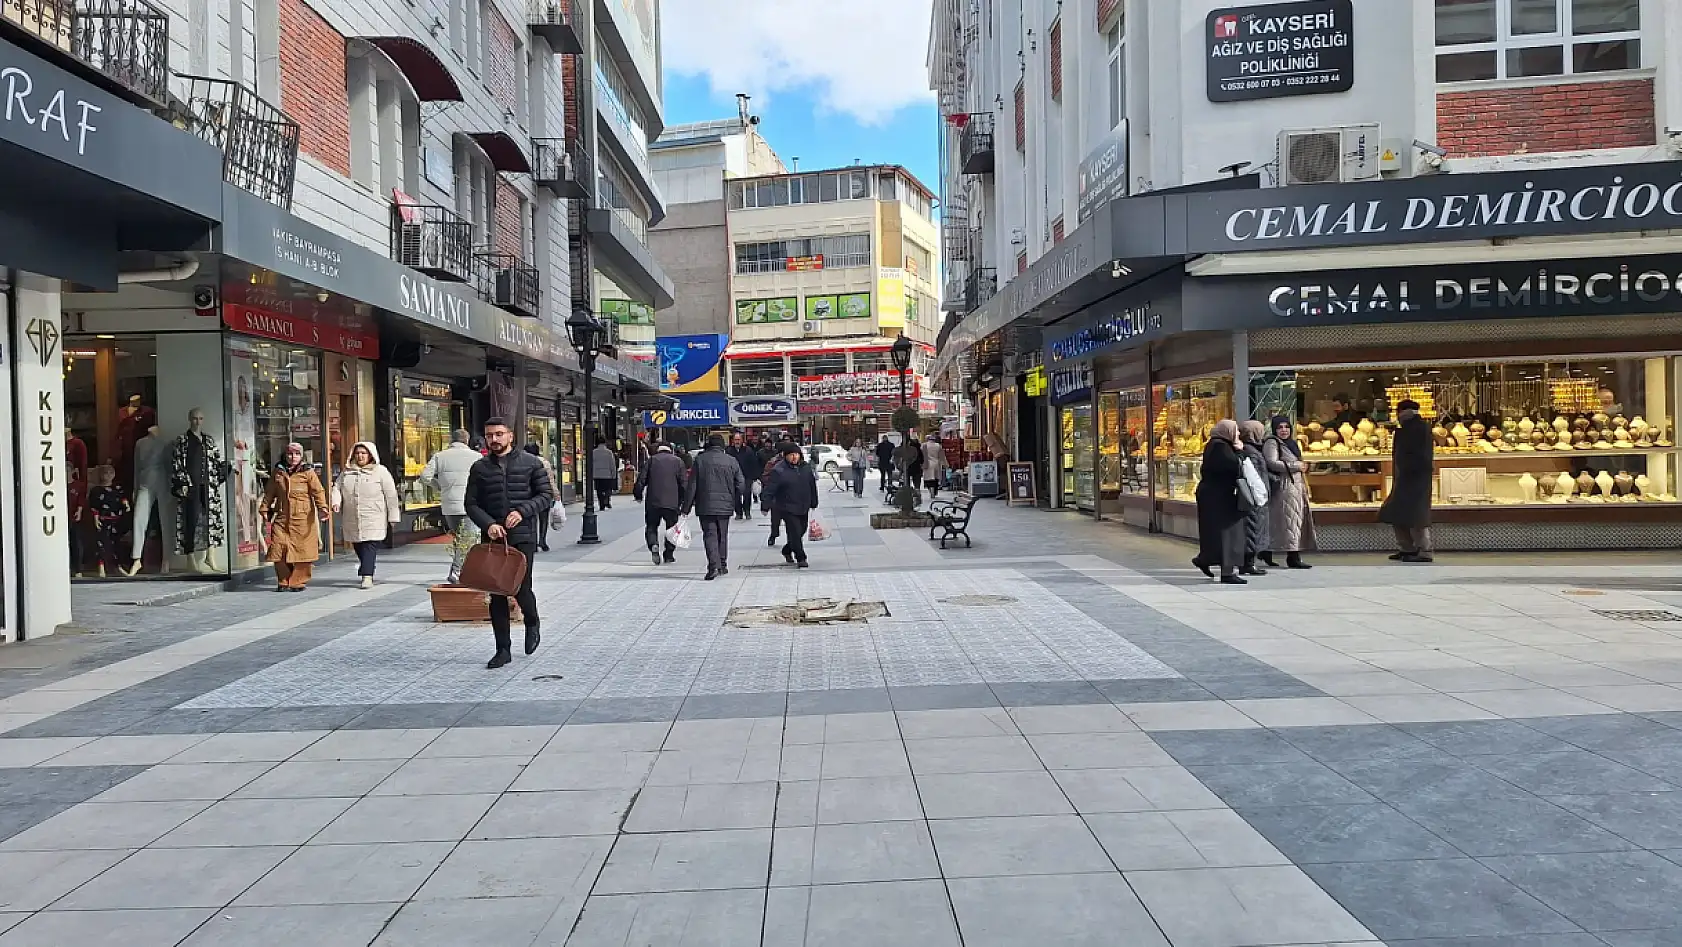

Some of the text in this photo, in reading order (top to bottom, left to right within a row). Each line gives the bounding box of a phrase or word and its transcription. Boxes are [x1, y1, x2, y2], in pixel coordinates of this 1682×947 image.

[1249, 9, 1335, 35] KAYSERİ
[1212, 31, 1348, 58] AĞIZ VE DİŞ SAĞLIĞI
[1240, 52, 1319, 74] POLİKLİNİĞİ
[1227, 82, 1245, 91] 0532
[1260, 79, 1270, 88] 07
[1286, 77, 1304, 86] 0352
[1305, 76, 1319, 84] 222
[1330, 74, 1340, 82] 44
[2, 67, 102, 155] RAF
[1225, 200, 1389, 241] CEMAL
[320, 263, 340, 279] BLOK
[400, 274, 471, 330] SAMANCI
[1268, 264, 1682, 317] CEMAL DEMİRCİO
[245, 311, 294, 338] SAMANCI
[741, 402, 773, 413] ÖRNEK
[38, 390, 55, 537] KUZUCU
